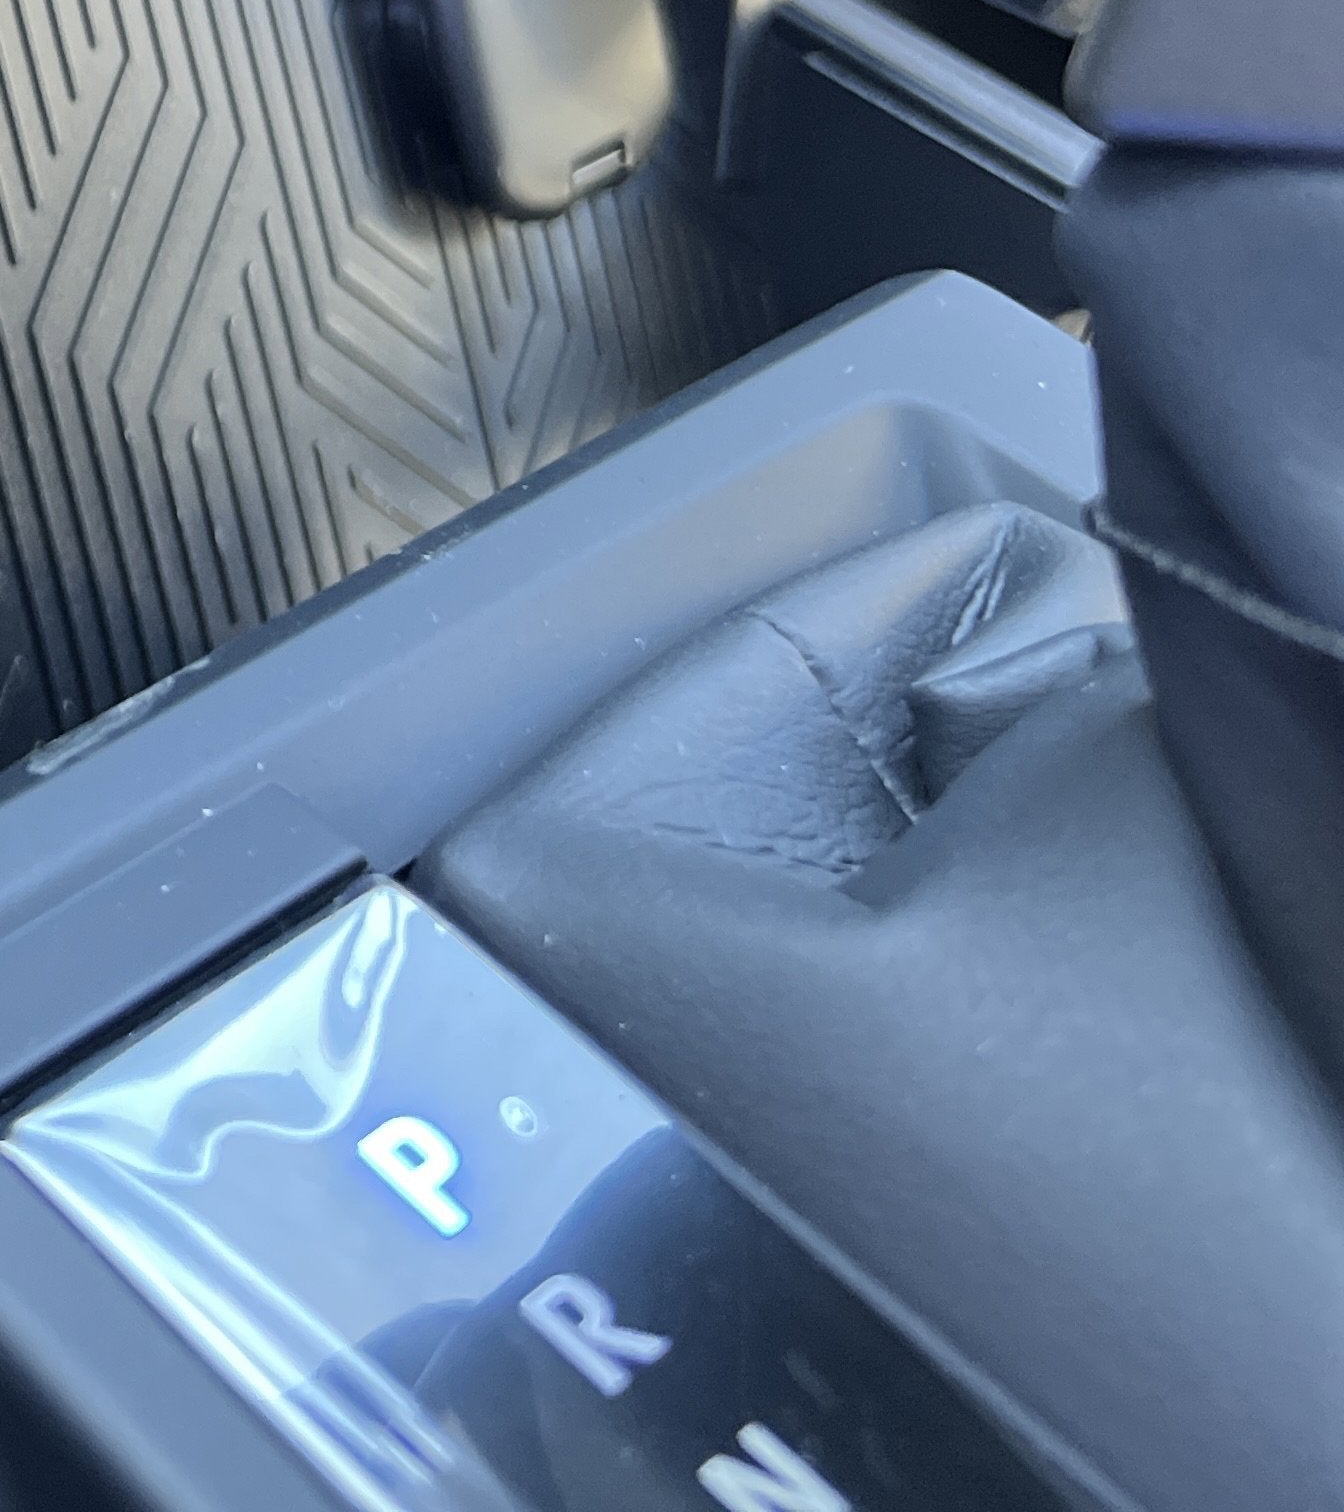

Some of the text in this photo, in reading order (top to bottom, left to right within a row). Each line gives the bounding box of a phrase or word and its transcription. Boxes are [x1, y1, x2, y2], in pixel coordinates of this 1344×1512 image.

[357, 1116, 472, 1239] P
[519, 1272, 673, 1399] R
[696, 1420, 853, 1512] N
